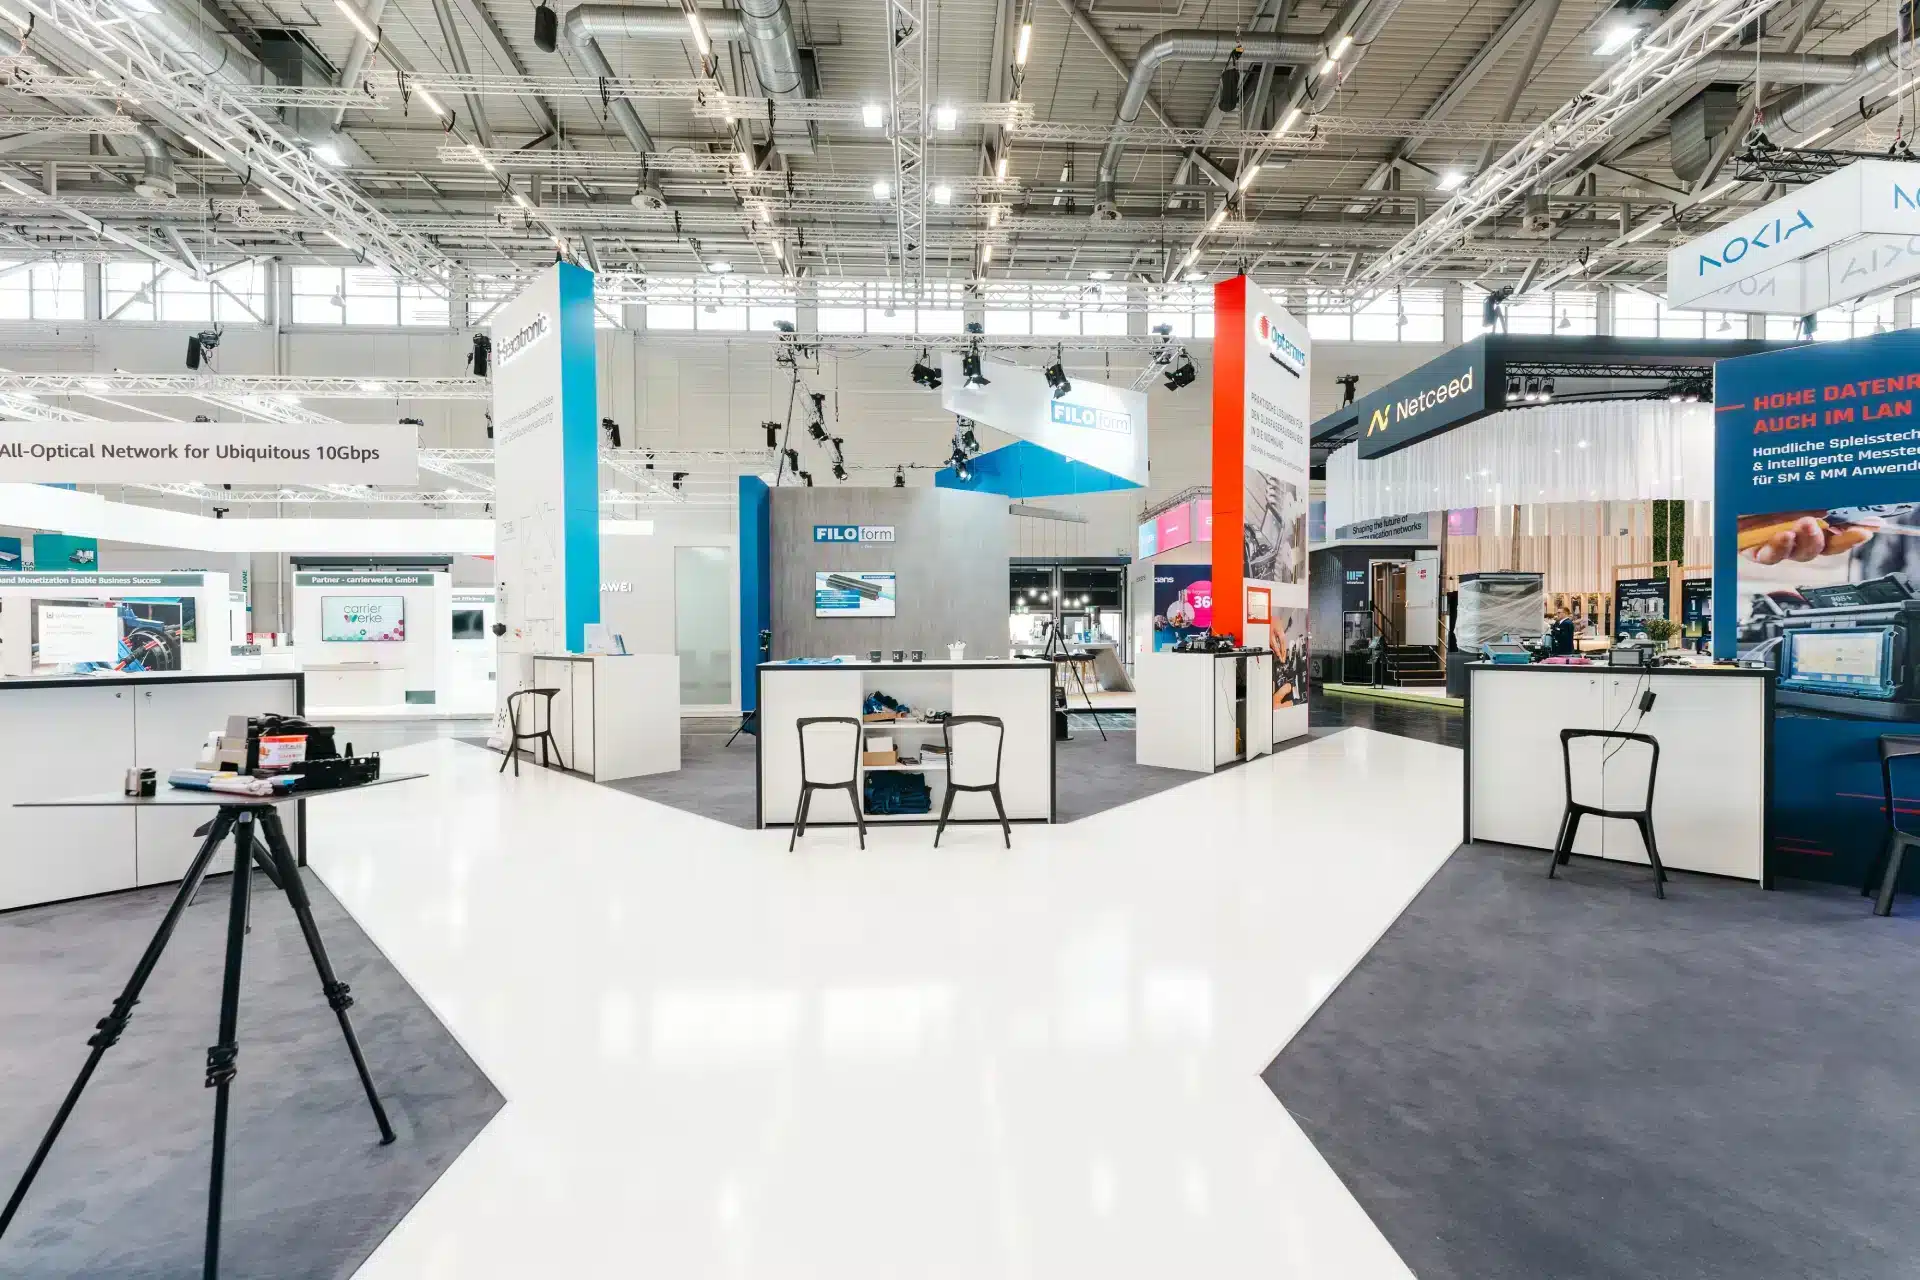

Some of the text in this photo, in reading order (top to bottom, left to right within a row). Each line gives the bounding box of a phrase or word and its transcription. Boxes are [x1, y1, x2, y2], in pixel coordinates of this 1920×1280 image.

[1699, 209, 1815, 276] NOKIA
[1396, 366, 1473, 422] Netceed
[1753, 373, 1920, 411] HOHE DATENR
[1752, 400, 1912, 434] AUCH IM LAN
[1752, 429, 1920, 457] Handliche Spleisstech
[0, 443, 380, 463] All-Optical Network for Ubiquitous 10Gbps
[1752, 461, 1763, 471] &
[1767, 453, 1854, 470] intelligente
[1752, 473, 1774, 485] für
[1777, 472, 1800, 483] SM
[1804, 470, 1816, 481] &
[1820, 467, 1847, 479] MM
[1352, 523, 1374, 535] Shaping
[1373, 520, 1383, 529] the
[1383, 517, 1401, 527] future
[1392, 521, 1422, 535] networks
[0, 576, 161, 584] and Monetization Enable Business Success
[311, 576, 340, 584] Partner
[346, 576, 393, 584] carrierwerke
[394, 576, 419, 584] GmbH
[343, 603, 383, 614] carrier
[1193, 596, 1212, 609] 36
